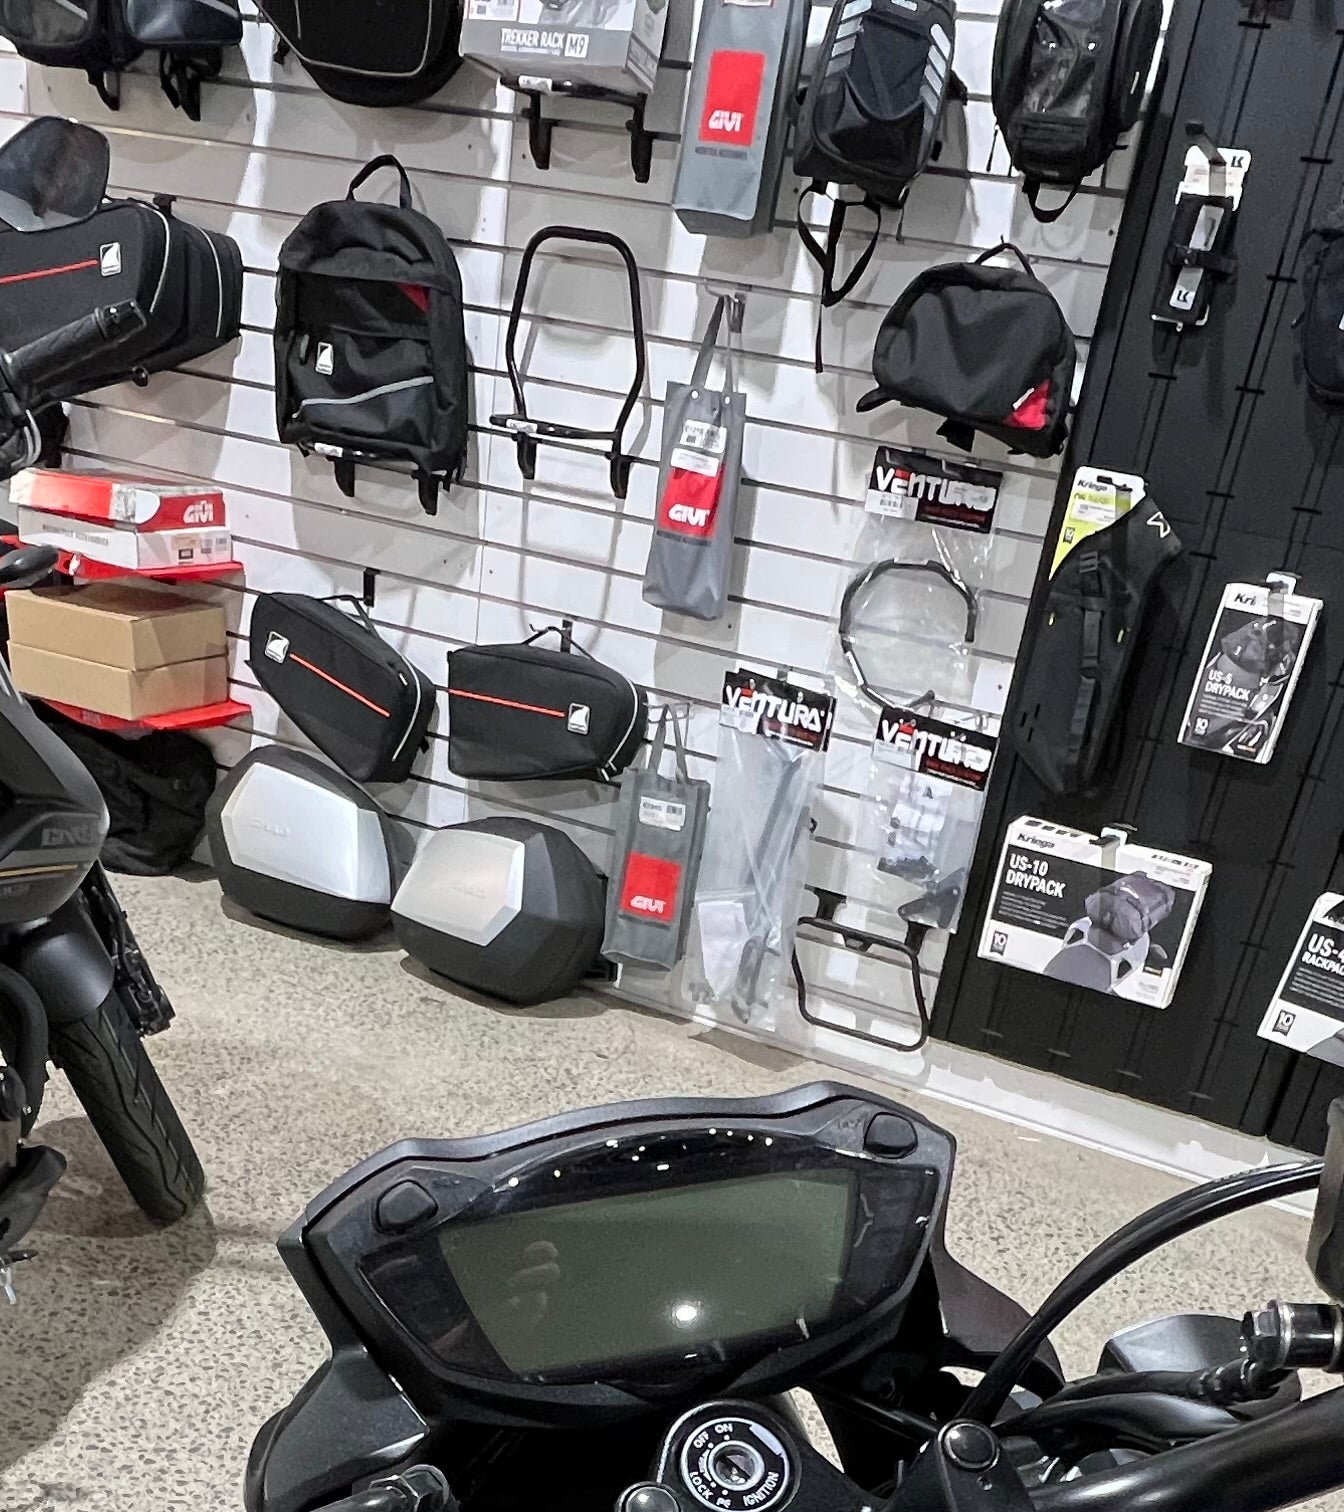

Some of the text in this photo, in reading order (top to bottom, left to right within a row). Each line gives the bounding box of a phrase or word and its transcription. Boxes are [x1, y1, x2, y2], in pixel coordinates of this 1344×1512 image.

[501, 27, 540, 48] TREKKER
[540, 31, 566, 49] RACK
[566, 33, 588, 58] M9
[708, 109, 743, 133] GIVI
[1076, 479, 1109, 493] Kriega
[182, 499, 215, 525] GIVI
[667, 503, 711, 527] GIVI
[1204, 680, 1251, 701] DRYPACK
[725, 683, 823, 733] VENTURA
[1016, 832, 1056, 850] Kriega
[1009, 852, 1050, 877] US-10
[1005, 868, 1067, 899] DRYPACK
[629, 894, 667, 914] GIVI
[692, 1430, 710, 1449] OFF
[714, 1423, 733, 1434] ON
[689, 1471, 714, 1500] LOCK
[742, 1471, 779, 1507] IGNITION
